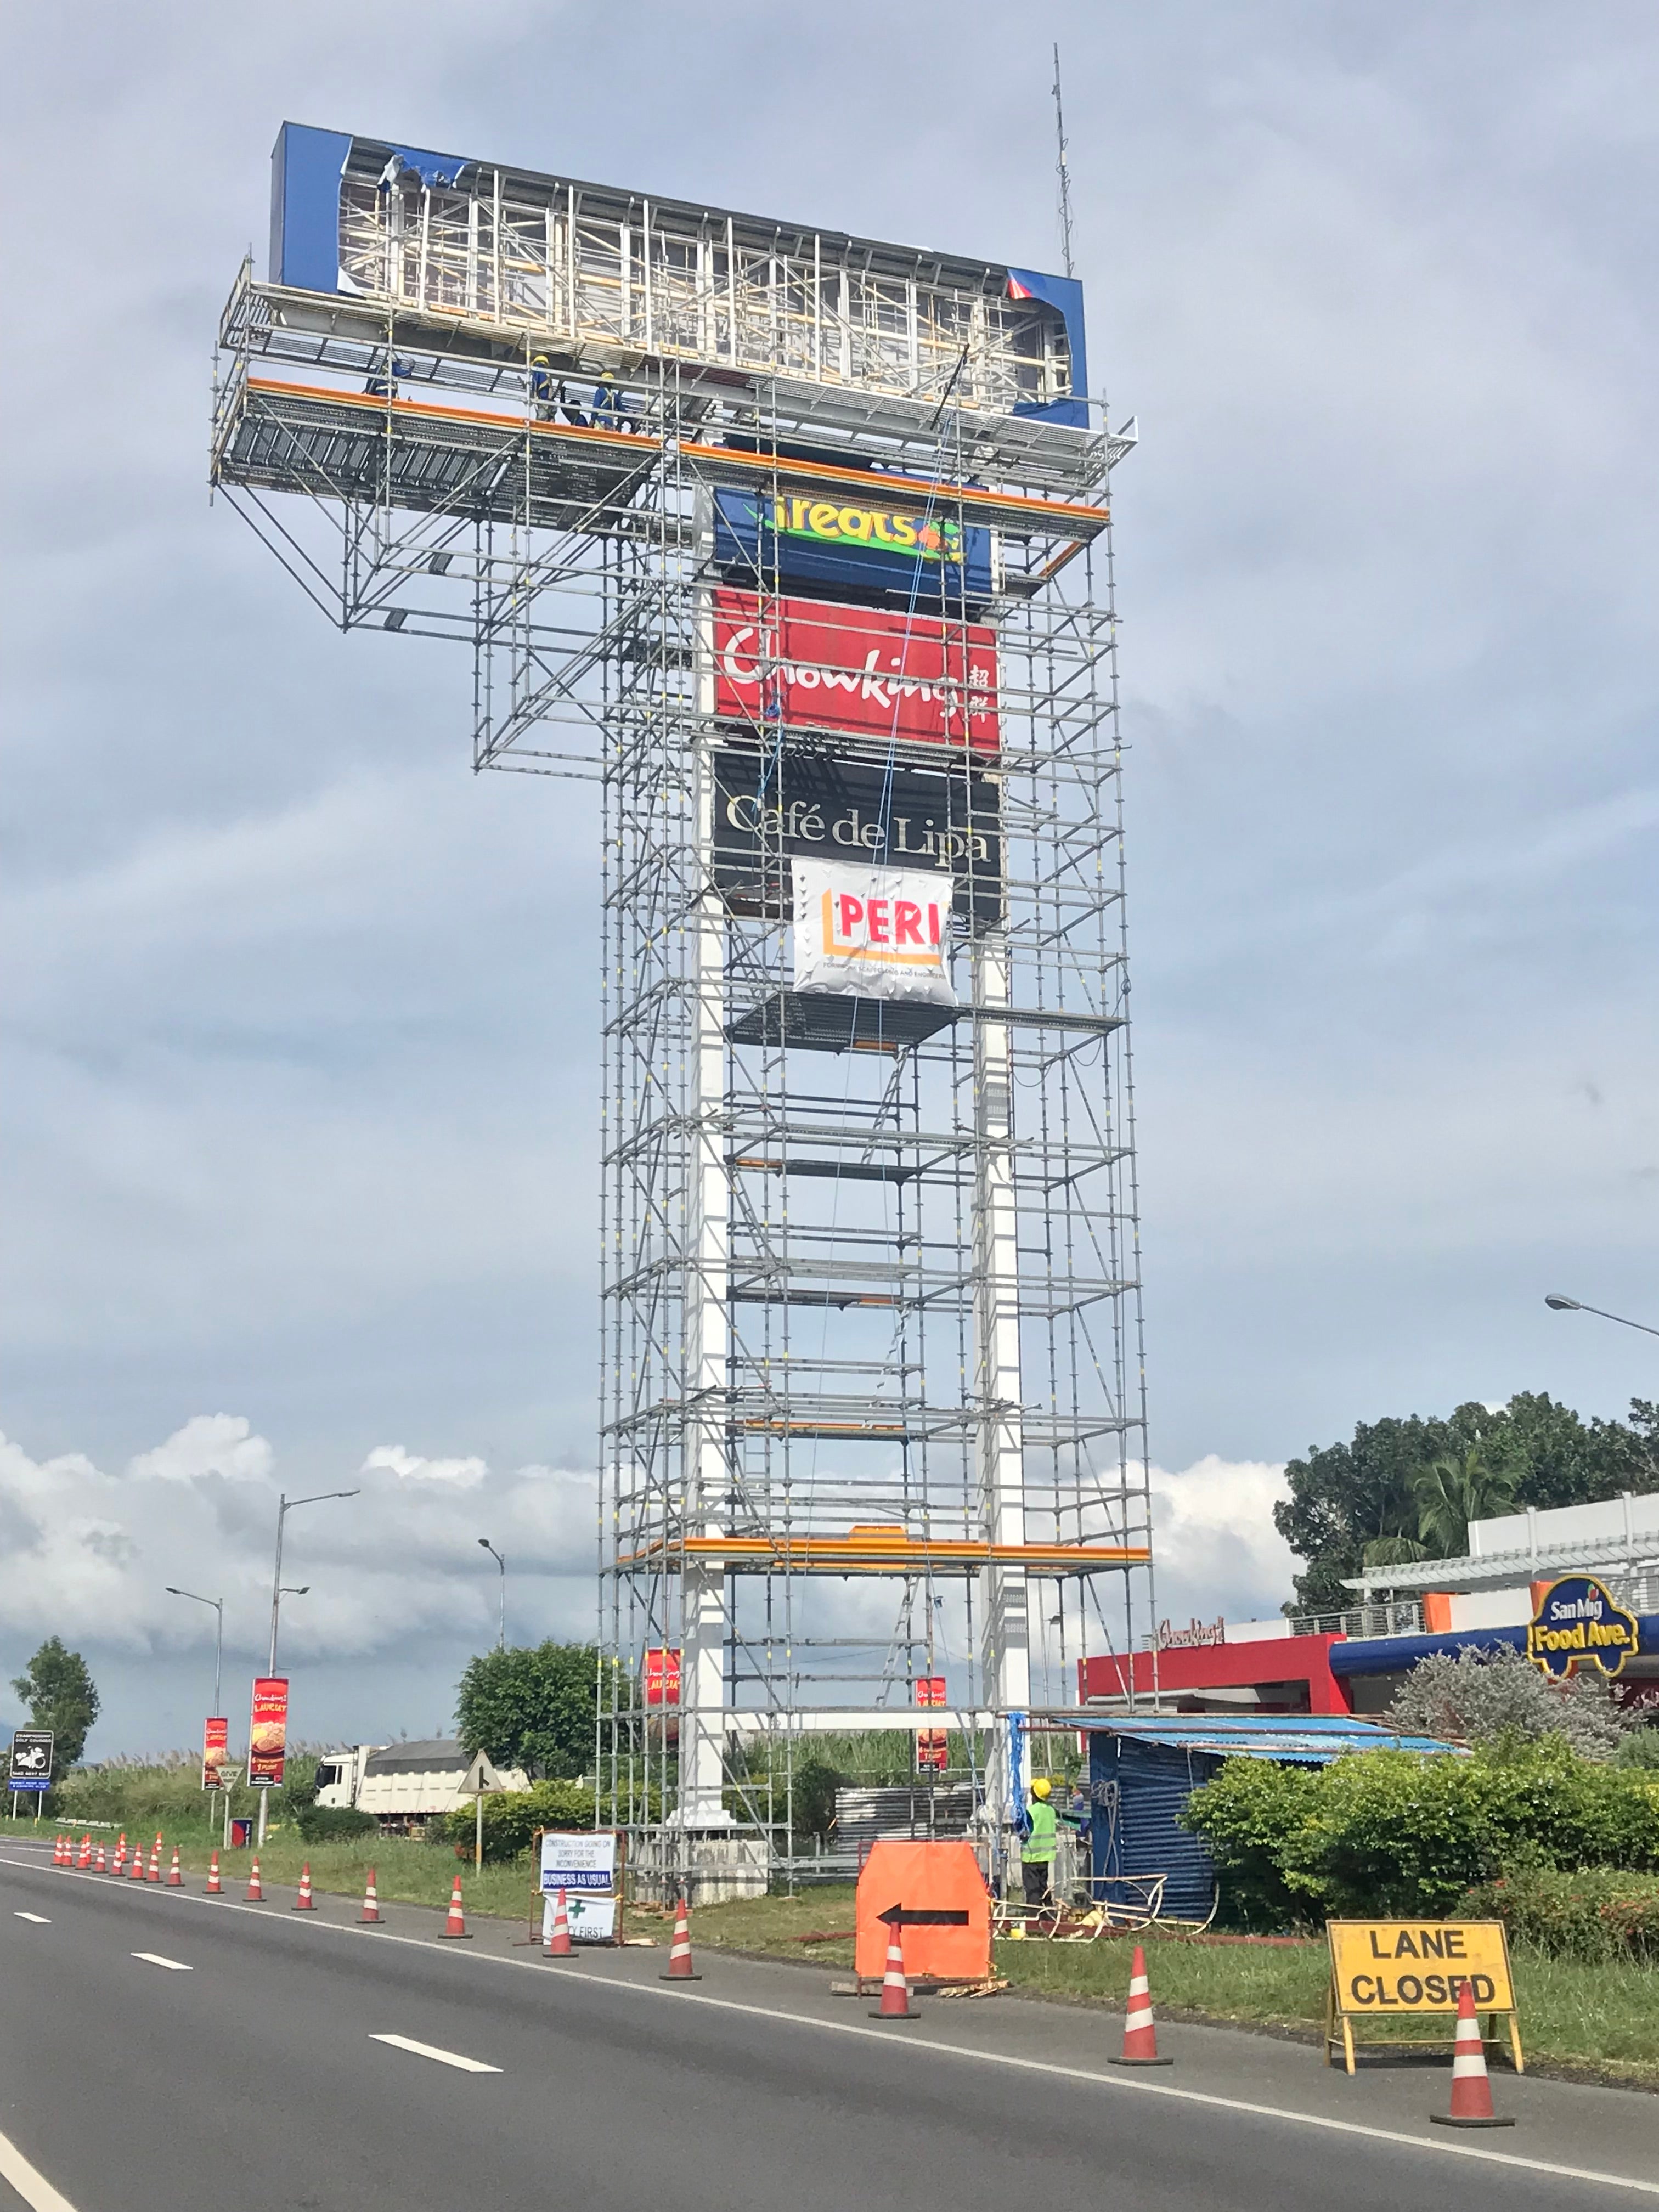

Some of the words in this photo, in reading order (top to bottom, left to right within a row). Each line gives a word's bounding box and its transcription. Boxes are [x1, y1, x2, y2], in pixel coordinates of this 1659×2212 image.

[723, 627, 958, 718] Chowking
[726, 795, 825, 841] Café
[832, 808, 885, 849] de
[893, 817, 991, 867] Lipa
[840, 893, 940, 945] PERI
[1550, 1601, 1576, 1621] San
[1577, 1598, 1602, 1621] Mig
[1535, 1622, 1585, 1651] Food
[1588, 1621, 1630, 1646] Ave.
[545, 1839, 583, 1848] CONSTRUCTION
[558, 1849, 573, 1858] SORRY
[574, 1849, 584, 1858] FOR
[585, 1849, 594, 1858] THE
[555, 1859, 596, 1868] INCONVENIENCE
[544, 1873, 576, 1886] BUSINESS
[577, 1874, 586, 1885] AS
[588, 1874, 611, 1886] USUAL
[579, 1926, 603, 1939] FIRST
[1369, 1930, 1468, 1959] LANE
